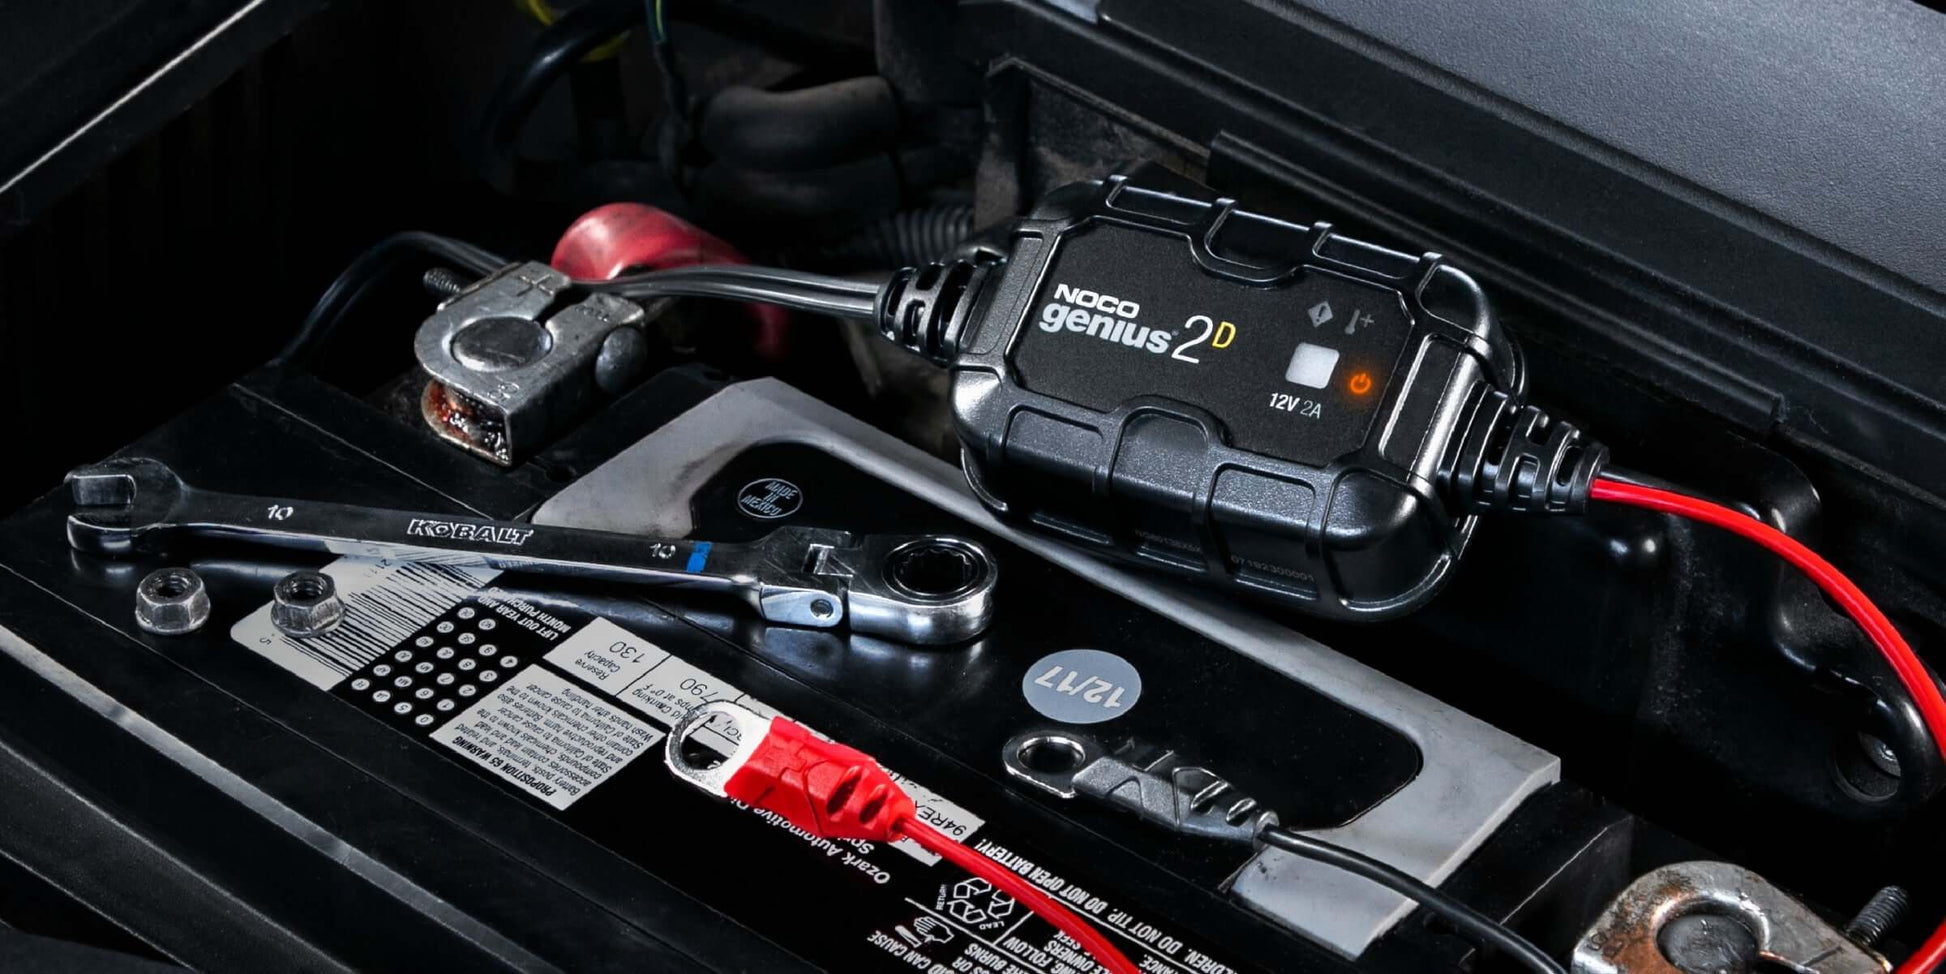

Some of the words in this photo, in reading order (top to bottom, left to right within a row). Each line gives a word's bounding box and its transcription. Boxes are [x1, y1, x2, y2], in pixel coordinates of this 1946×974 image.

[1054, 283, 1140, 319] NOCO
[1038, 301, 1173, 355] genius
[1268, 391, 1301, 412] 12V
[1300, 399, 1323, 420] 2A
[762, 491, 781, 504] IN
[764, 481, 798, 501] MADE
[267, 503, 294, 521] 10
[740, 494, 783, 516] MEXICO
[406, 518, 535, 546] KOBALT
[649, 541, 677, 560] 10
[496, 605, 519, 620] YEAR
[518, 618, 539, 629] OUT
[537, 613, 570, 632] MONTH
[536, 627, 558, 640] LIFT
[609, 641, 644, 662] 130
[575, 659, 609, 680] Reserve
[584, 651, 620, 672] Capacity
[507, 686, 519, 695] the
[680, 678, 718, 703] 790
[1033, 665, 1126, 709] 12/17
[498, 694, 513, 703] also
[528, 697, 553, 712] known
[551, 697, 572, 709] cause
[632, 689, 671, 713] Cranking
[477, 709, 490, 718] the
[512, 702, 543, 721] Batteries
[552, 710, 588, 731] chemicals
[591, 706, 610, 717] after
[454, 724, 481, 739] related
[474, 721, 492, 732] lead
[498, 720, 522, 735] known
[522, 720, 543, 733] cause
[580, 712, 615, 733] California
[609, 715, 632, 730] hands
[479, 737, 496, 747] and
[489, 730, 506, 740] and
[504, 738, 522, 749] lead
[520, 733, 557, 754] chemicals
[563, 730, 608, 755] reproductive
[586, 730, 606, 741] other
[623, 735, 643, 748] State
[632, 727, 653, 741] Wash
[452, 736, 491, 760] WARNING
[521, 747, 549, 762] contain
[551, 737, 584, 757] California
[606, 740, 632, 755] contain
[489, 758, 503, 766] 65
[592, 759, 611, 772] State
[605, 754, 622, 763] and
[500, 764, 556, 795] PROPOSITION
[548, 761, 591, 786] accessories
[552, 777, 580, 795] Battery
[753, 807, 843, 857] Automotive
[973, 838, 1036, 876] BATTERY!
[841, 851, 891, 885] Ozark
[1028, 866, 1065, 892] OPEN
[1058, 884, 1091, 905] NOT
[1083, 897, 1109, 915] DO
[979, 921, 1005, 931] LEAD
[1107, 908, 1134, 929] TIP.
[1128, 922, 1162, 944] NOT
[866, 930, 908, 957] CAUSE
[1002, 936, 1052, 968] FOLLOW
[1157, 937, 1183, 955] DO
[903, 950, 932, 969] CAN
[951, 956, 974, 973] OR
[964, 943, 1008, 972] BURNS
[1043, 940, 1096, 972] OWNERS
